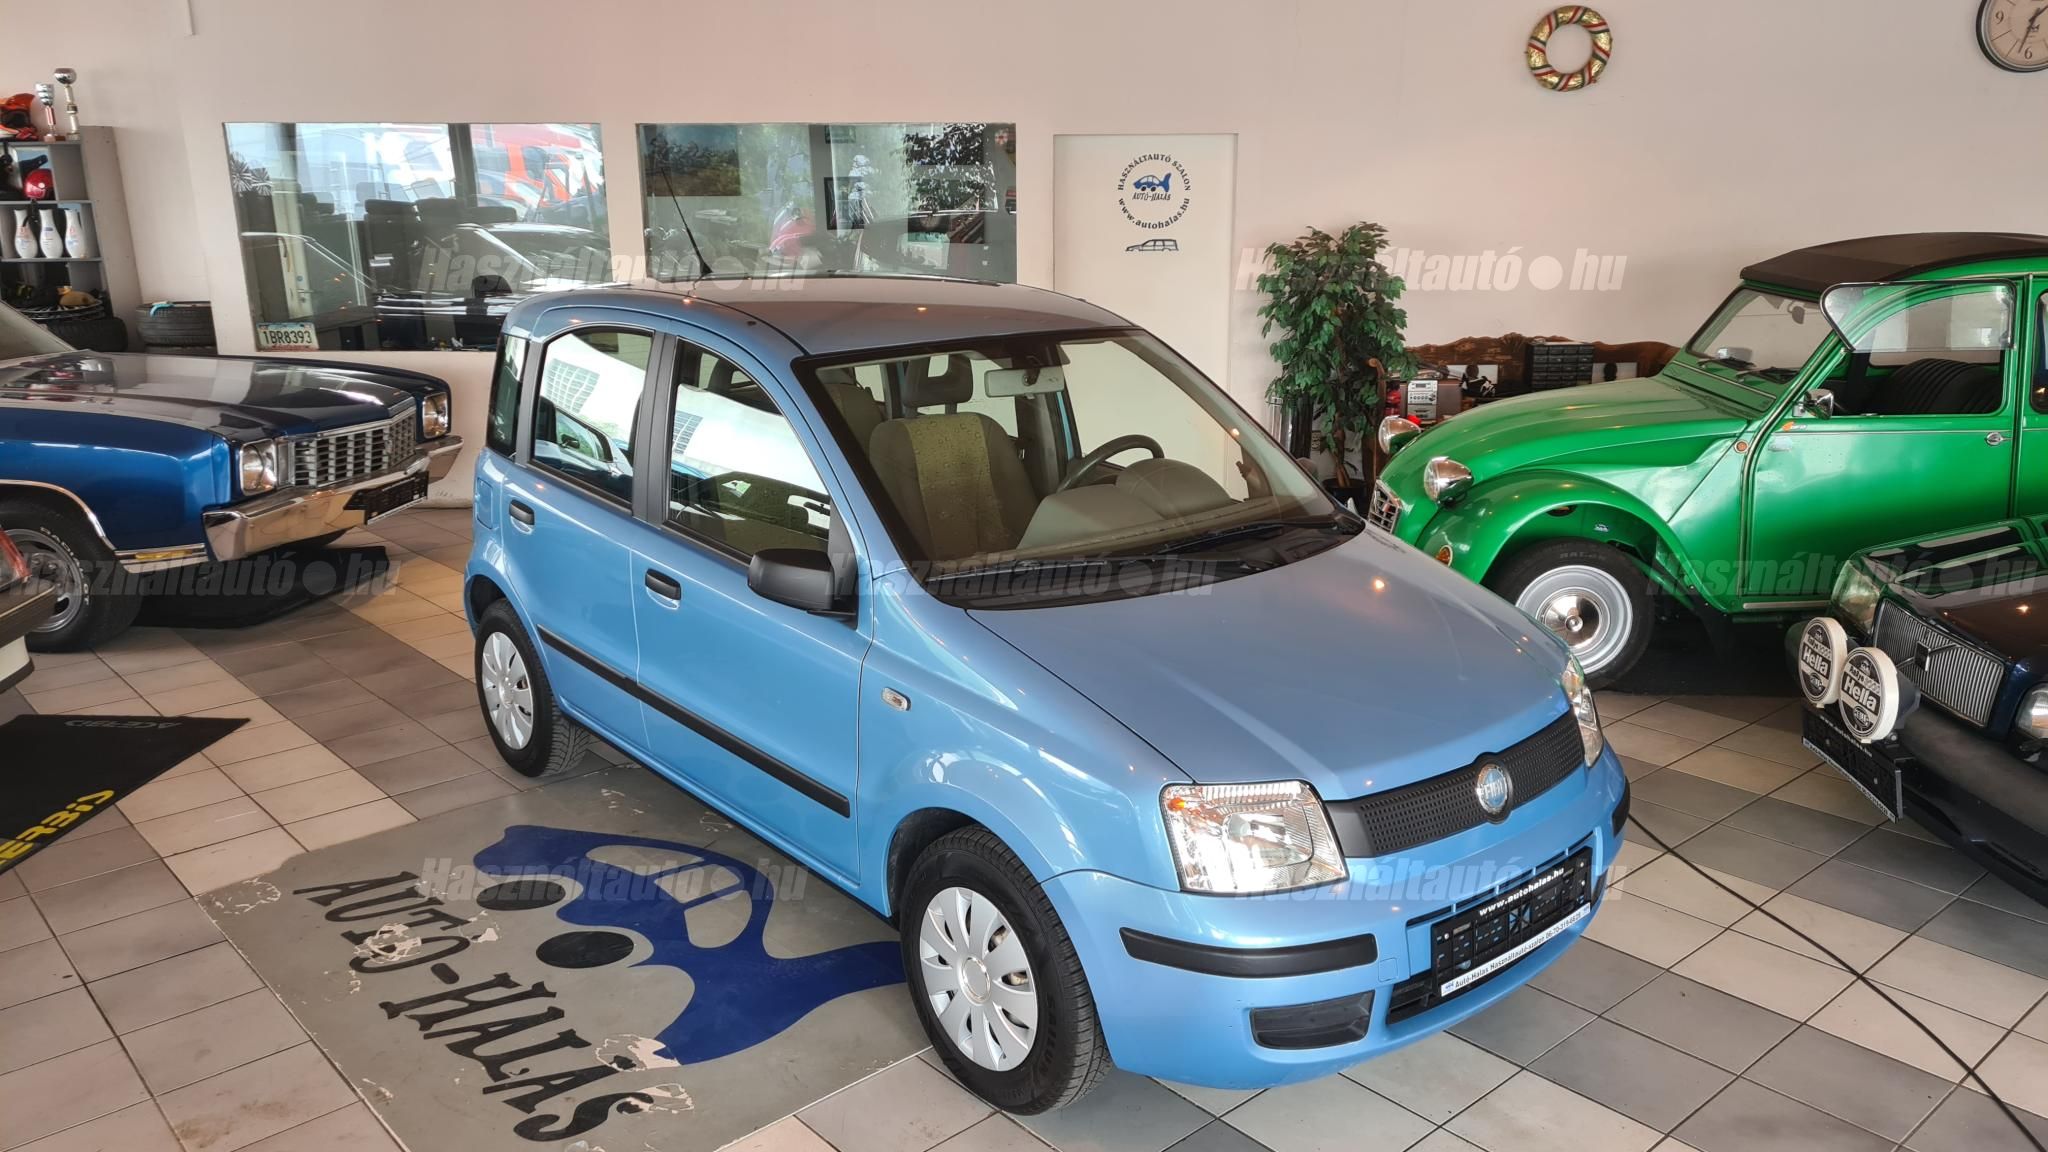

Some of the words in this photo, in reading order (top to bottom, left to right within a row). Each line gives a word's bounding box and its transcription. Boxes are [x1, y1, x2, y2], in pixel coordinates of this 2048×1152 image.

[1995, 10, 2004, 24] 9
[2024, 46, 2032, 59] 6
[1118, 153, 1172, 191] HASZNÁLTAUTÓ
[1171, 160, 1192, 191] SZALON
[1118, 198, 1190, 229] www.autohalas.hu
[263, 330, 313, 344] 1BR8393
[1803, 647, 1829, 676] Hella
[1844, 676, 1877, 712] Hella
[1485, 779, 1504, 799] FIAT
[1479, 867, 1565, 916] www.autohalas.hu
